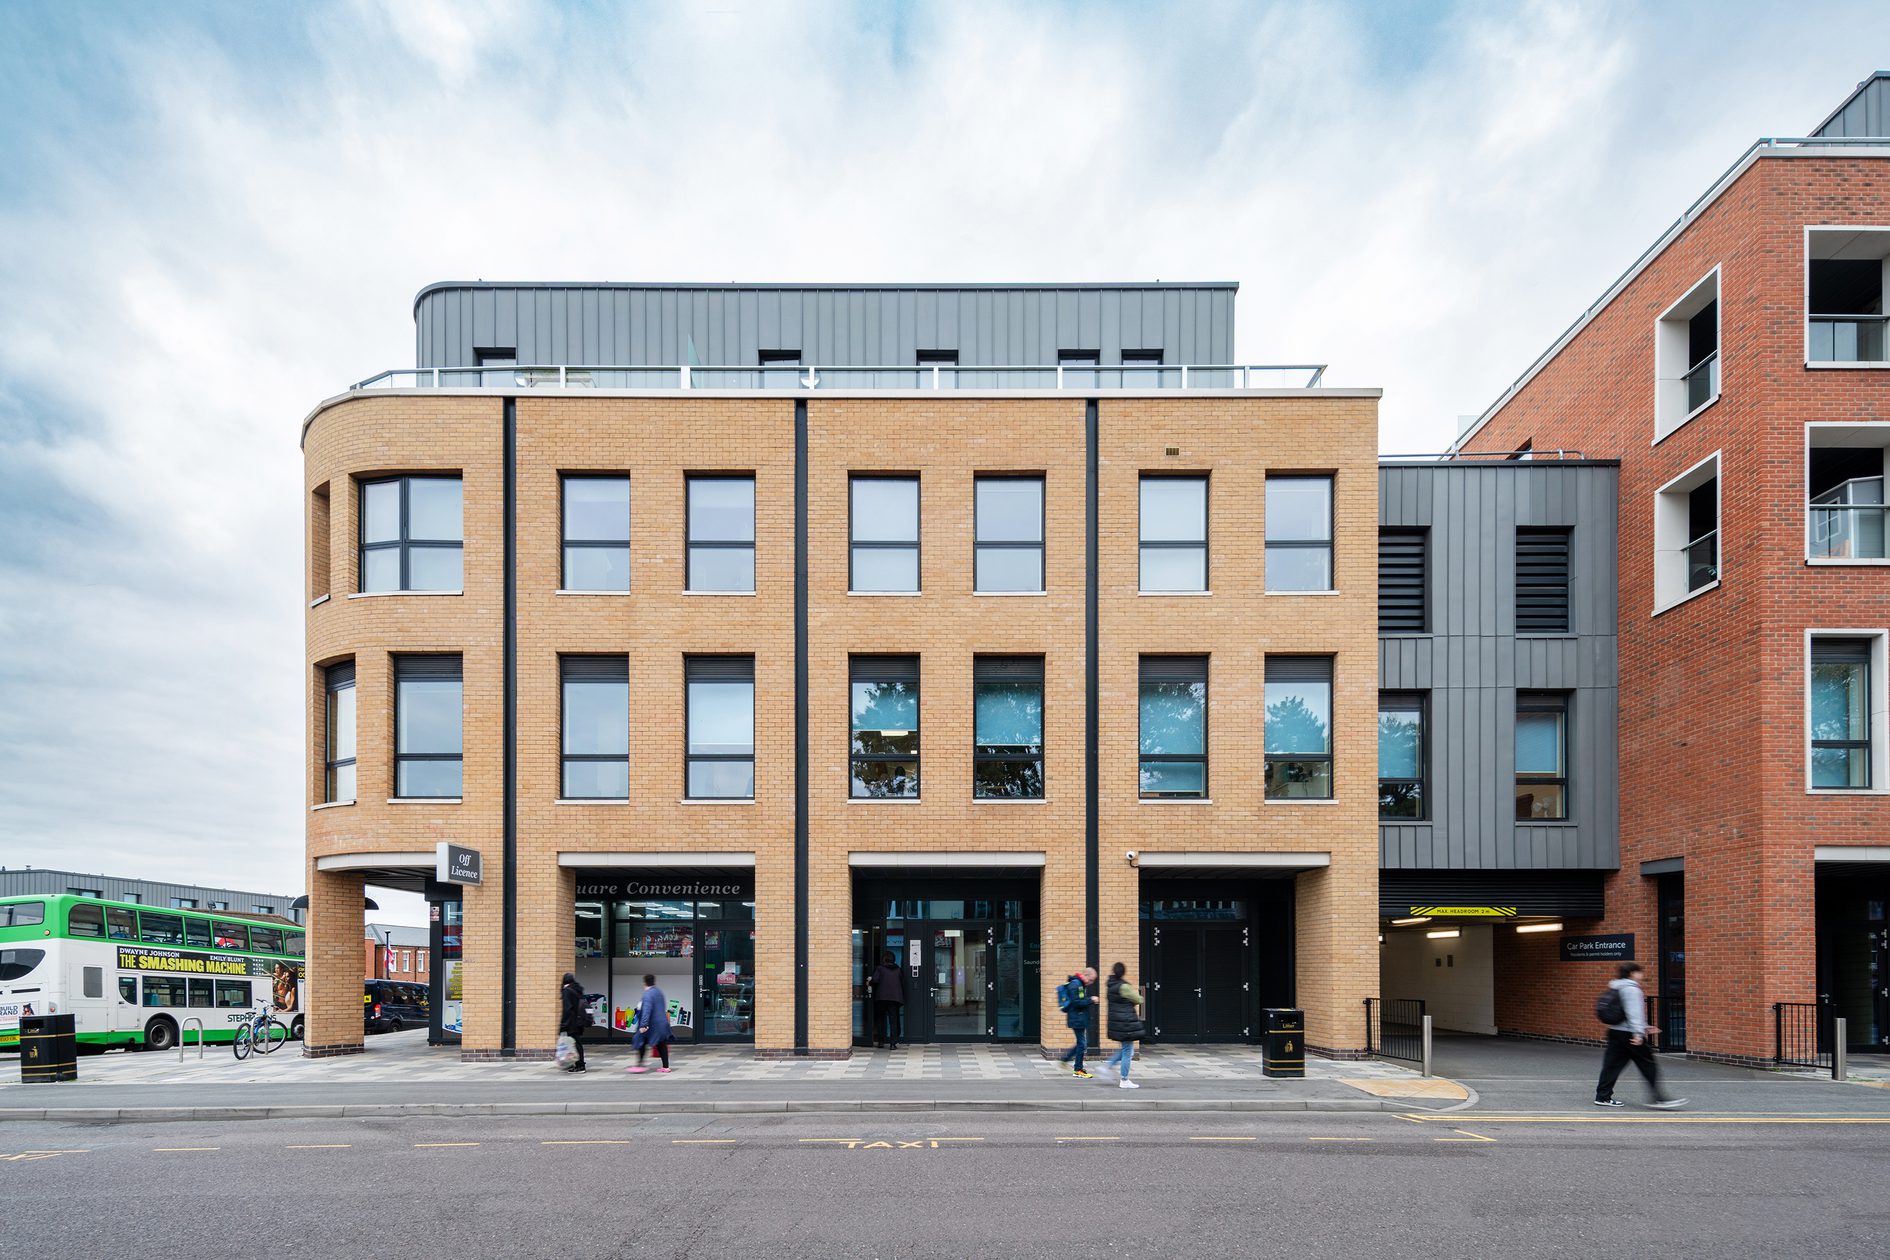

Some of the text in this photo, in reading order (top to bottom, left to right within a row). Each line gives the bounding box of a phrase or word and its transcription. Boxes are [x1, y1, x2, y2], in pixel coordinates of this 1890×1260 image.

[459, 854, 471, 866] Off
[451, 866, 478, 879] Licence
[626, 881, 741, 895] Convenience
[1566, 941, 1626, 950] Car Park Entrance
[119, 947, 180, 958] DWAYNE JOHNSON
[119, 954, 247, 975] THE SMASHING MACHINE
